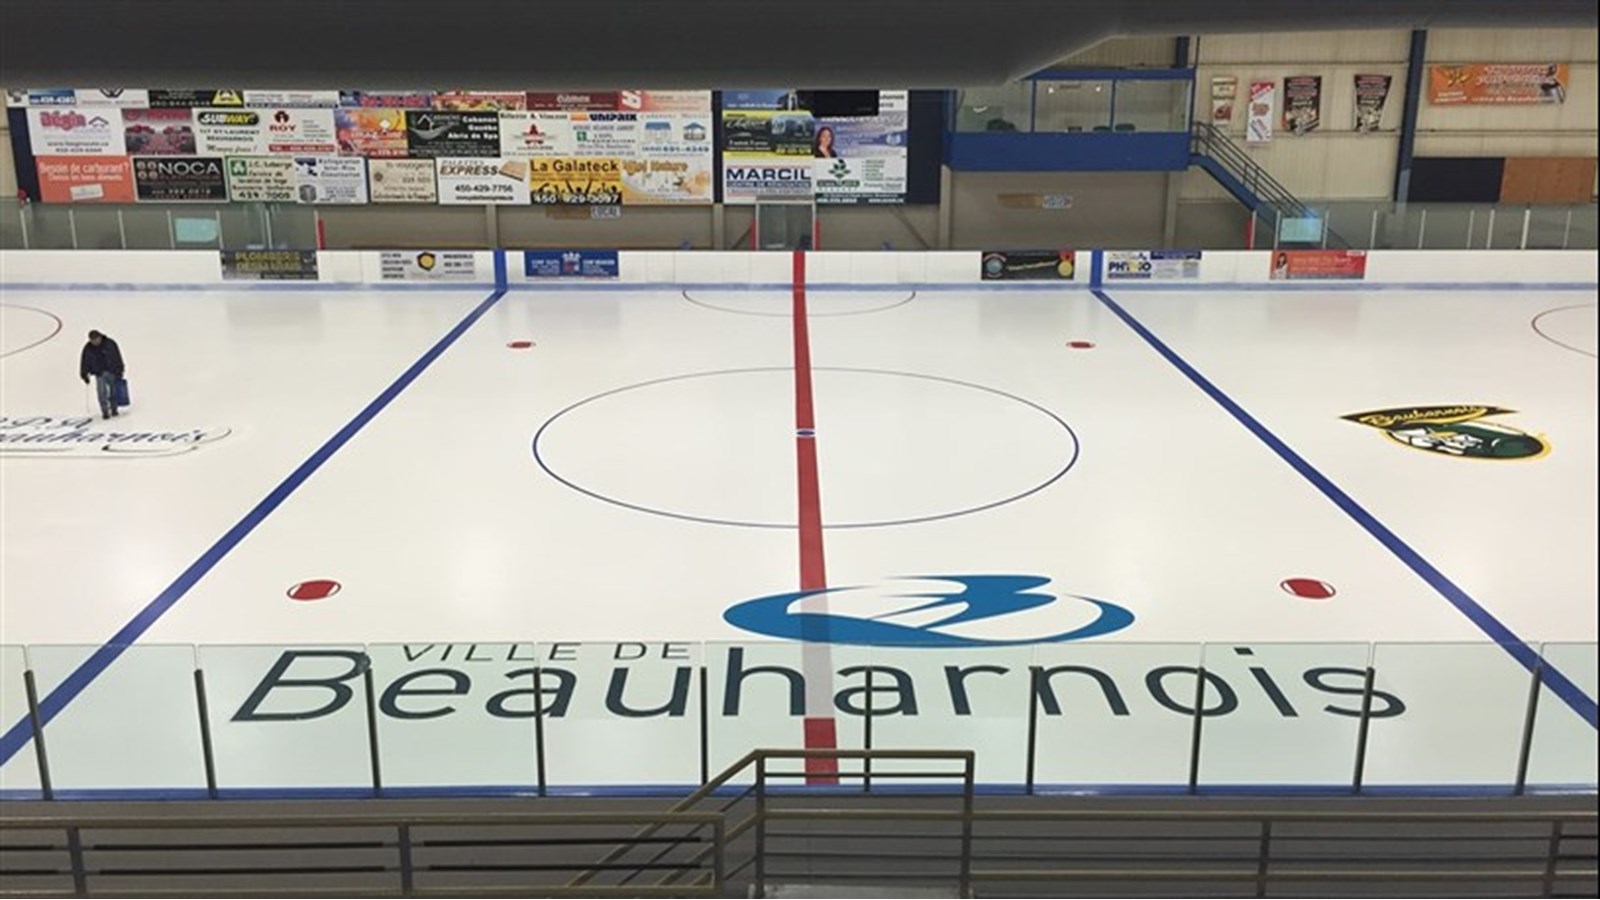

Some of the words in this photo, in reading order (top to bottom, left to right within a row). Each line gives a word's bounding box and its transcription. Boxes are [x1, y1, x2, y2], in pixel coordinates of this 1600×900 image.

[201, 113, 249, 124] SUBWAY
[269, 124, 297, 132] ROY
[158, 162, 220, 175] NOCA
[440, 165, 498, 176] EXPRESS
[530, 160, 548, 172] La
[553, 160, 620, 172] Galateck
[727, 168, 812, 179] MARCIL
[401, 642, 581, 662] VILLE
[612, 642, 692, 661] DE
[229, 645, 1407, 722] Beauharnois
